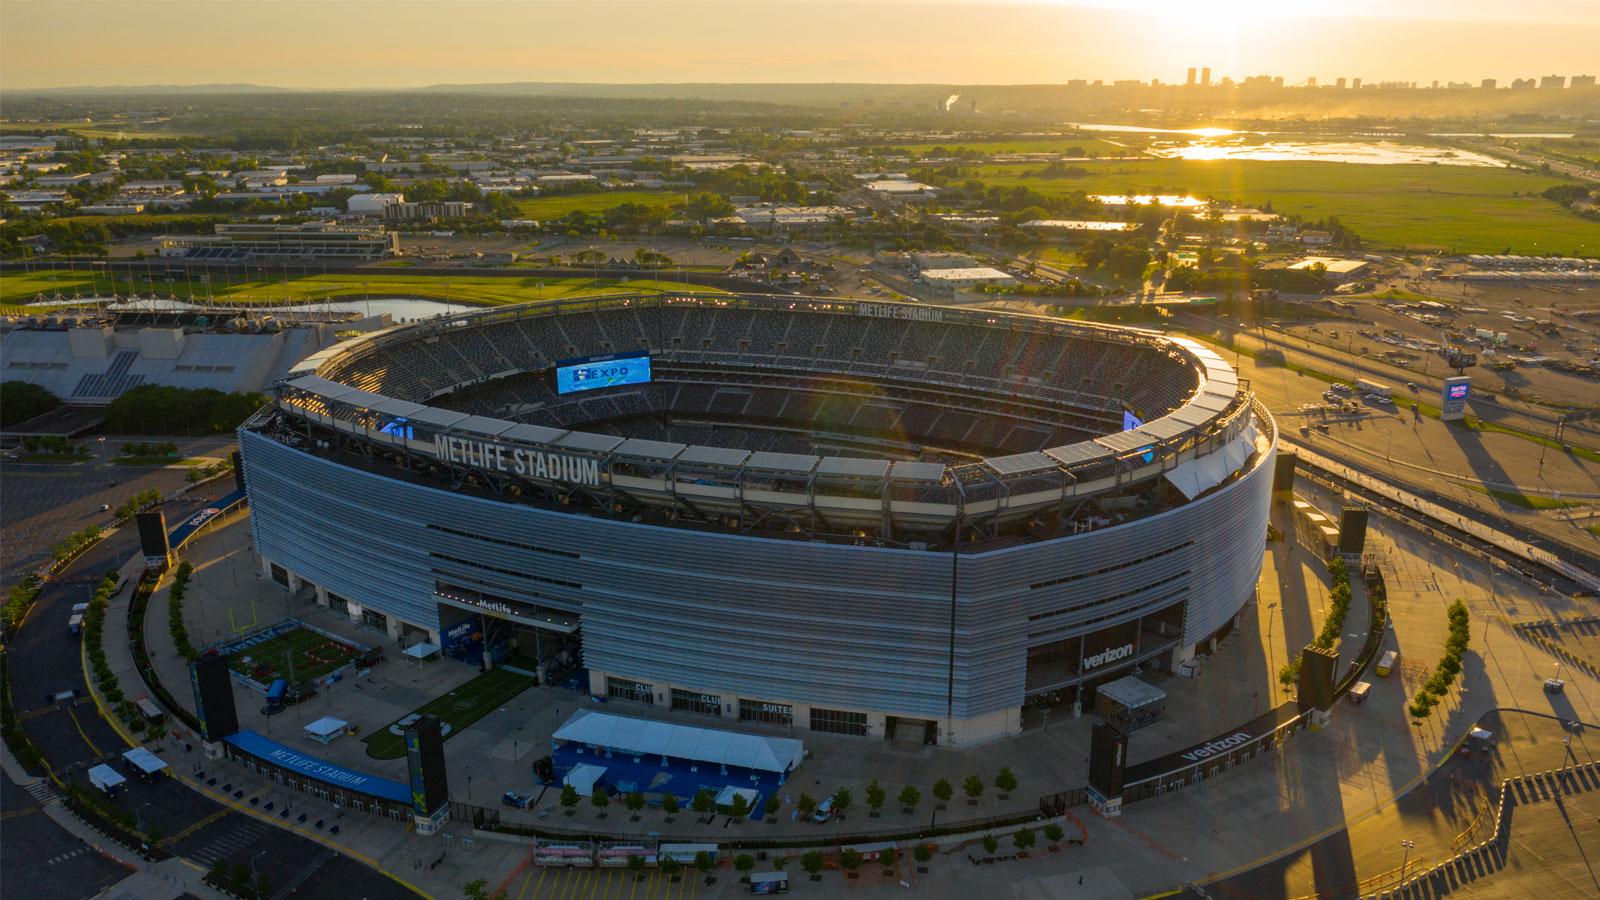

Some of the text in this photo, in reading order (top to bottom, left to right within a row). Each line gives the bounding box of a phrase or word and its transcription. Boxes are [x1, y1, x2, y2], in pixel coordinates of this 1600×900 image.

[860, 303, 943, 322] METLIFE STADIUM
[591, 367, 629, 379] EXPO
[434, 434, 599, 486] METLIFE STADIUM
[1084, 643, 1134, 670] verizon
[1181, 731, 1252, 762] verizon
[271, 749, 368, 786] METLIFE STADIUM
